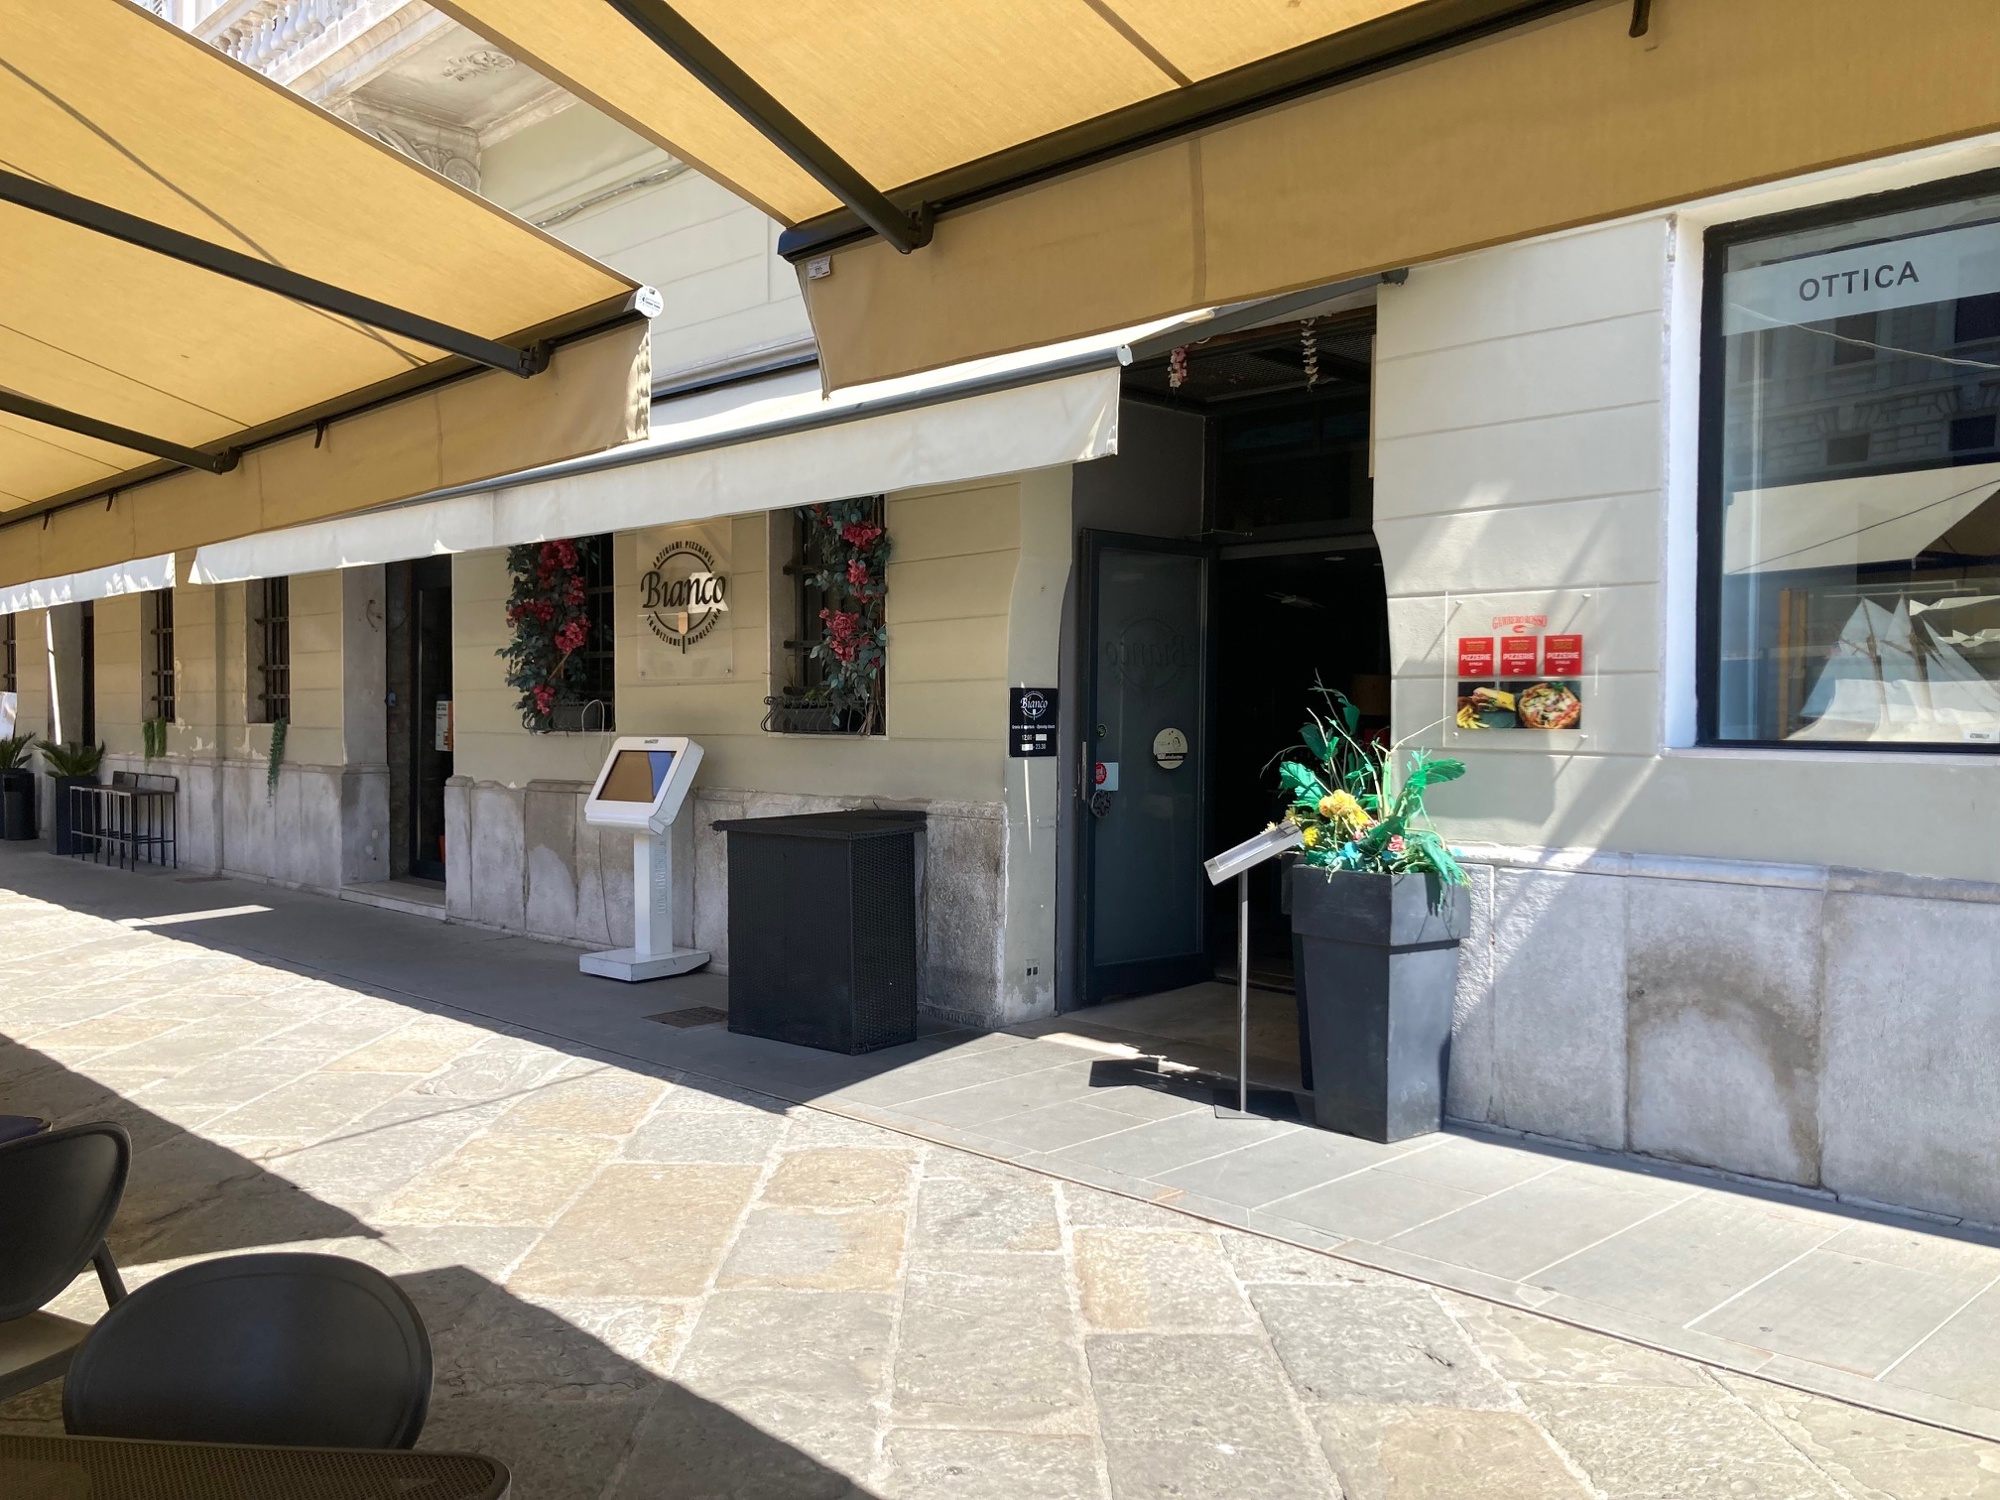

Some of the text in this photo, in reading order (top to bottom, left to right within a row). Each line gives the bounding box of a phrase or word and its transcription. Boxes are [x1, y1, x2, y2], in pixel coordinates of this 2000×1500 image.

[1799, 261, 1920, 302] OTTICA
[640, 571, 726, 608] Bianco
[646, 608, 721, 646] TRADIZIONE NAPOLETANA
[1020, 696, 1049, 709] Bianco
